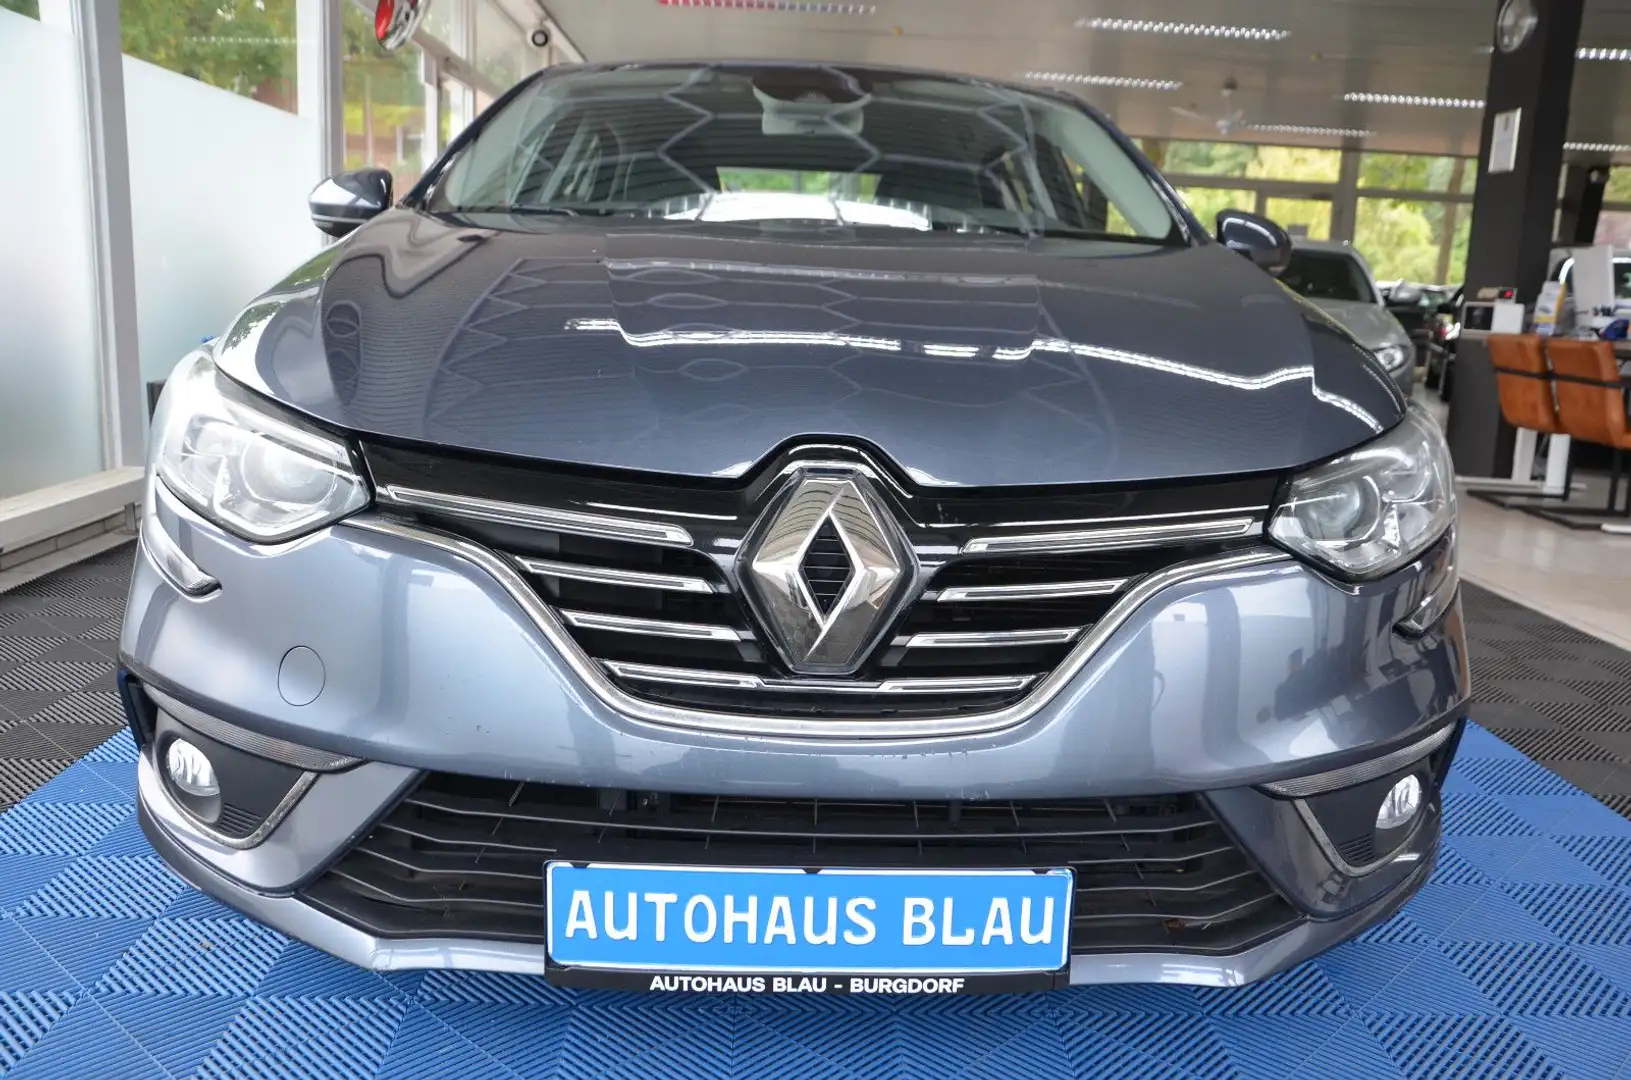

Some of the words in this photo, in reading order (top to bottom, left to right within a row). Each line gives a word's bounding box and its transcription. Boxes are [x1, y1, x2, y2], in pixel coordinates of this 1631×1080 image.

[565, 889, 877, 945] AUTOHAUS
[902, 897, 1055, 946] BLAU
[649, 975, 766, 993] AUTOHAUS
[772, 977, 827, 993] BLAU
[850, 977, 965, 994] BURGDORF
